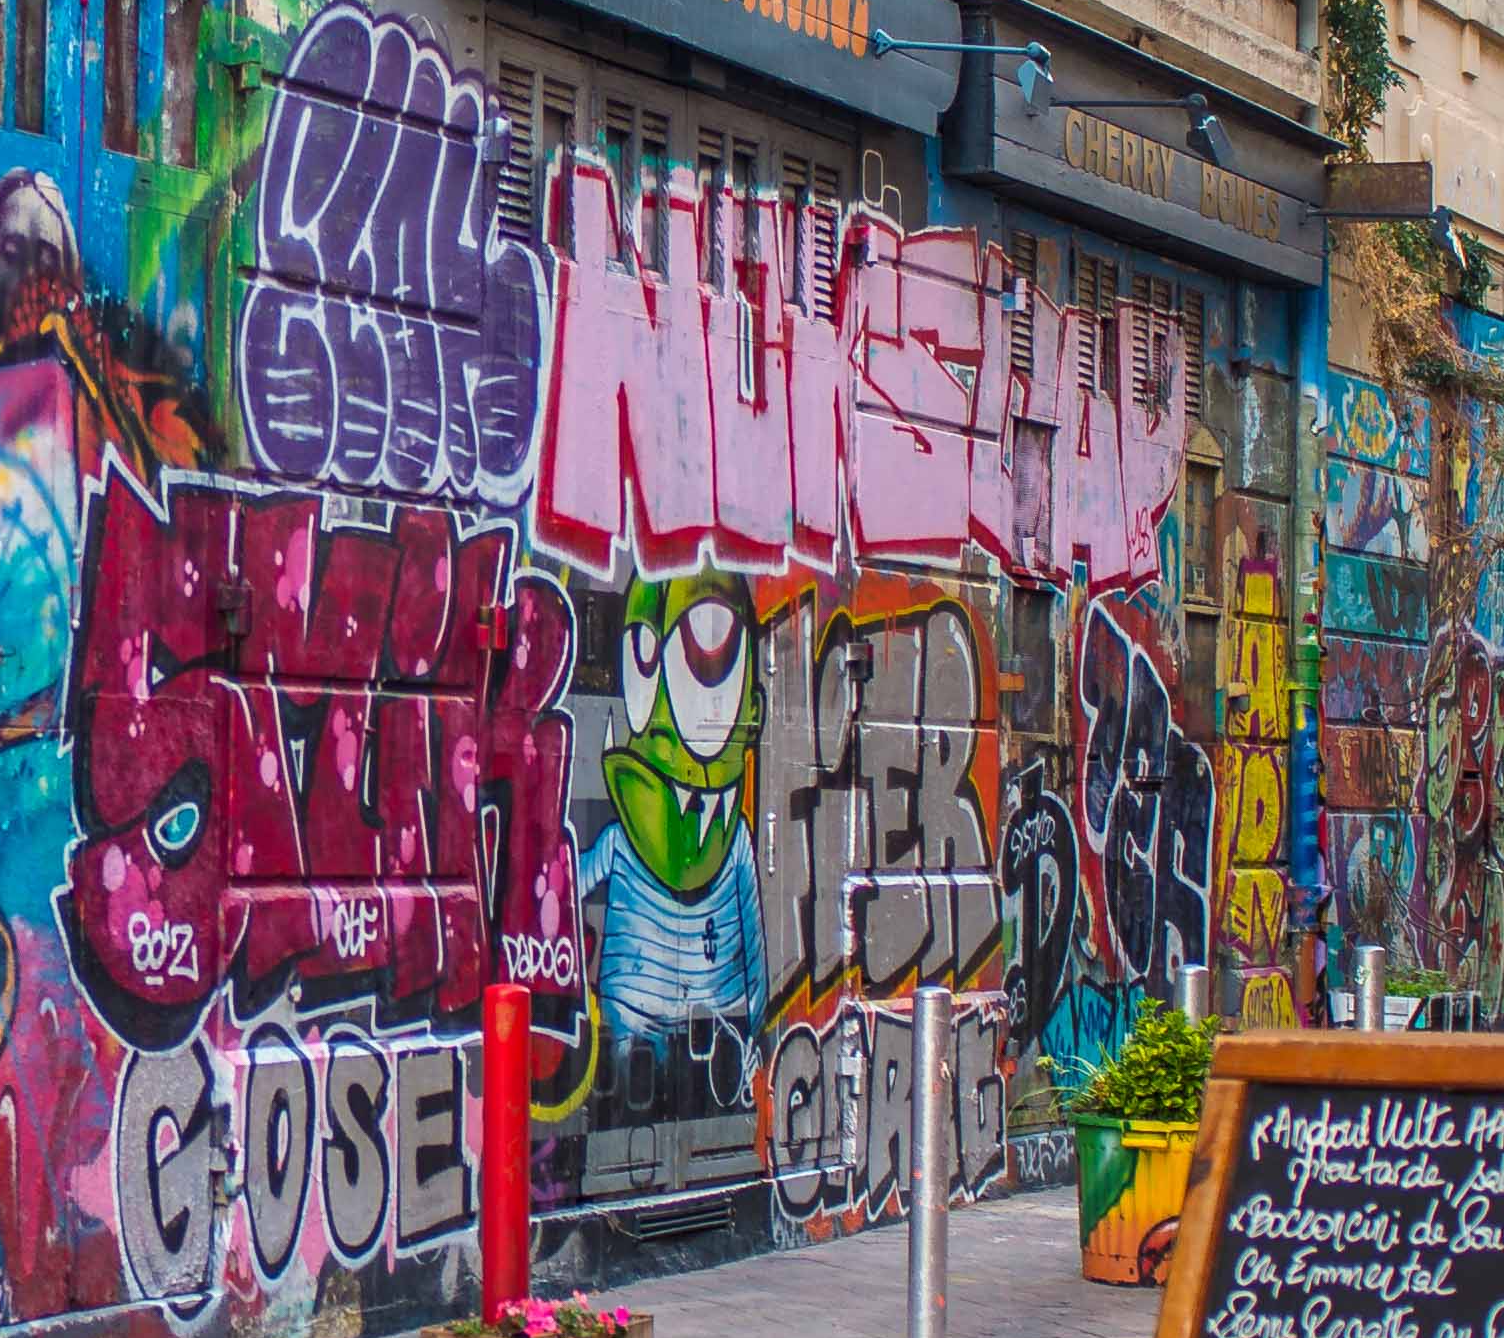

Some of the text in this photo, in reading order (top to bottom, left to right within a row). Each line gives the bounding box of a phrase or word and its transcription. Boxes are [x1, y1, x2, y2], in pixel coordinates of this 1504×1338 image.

[1064, 106, 1281, 244] CHERRY BONES
[1408, 1197, 1448, 1245] de
[1285, 1246, 1458, 1302] Emmental
